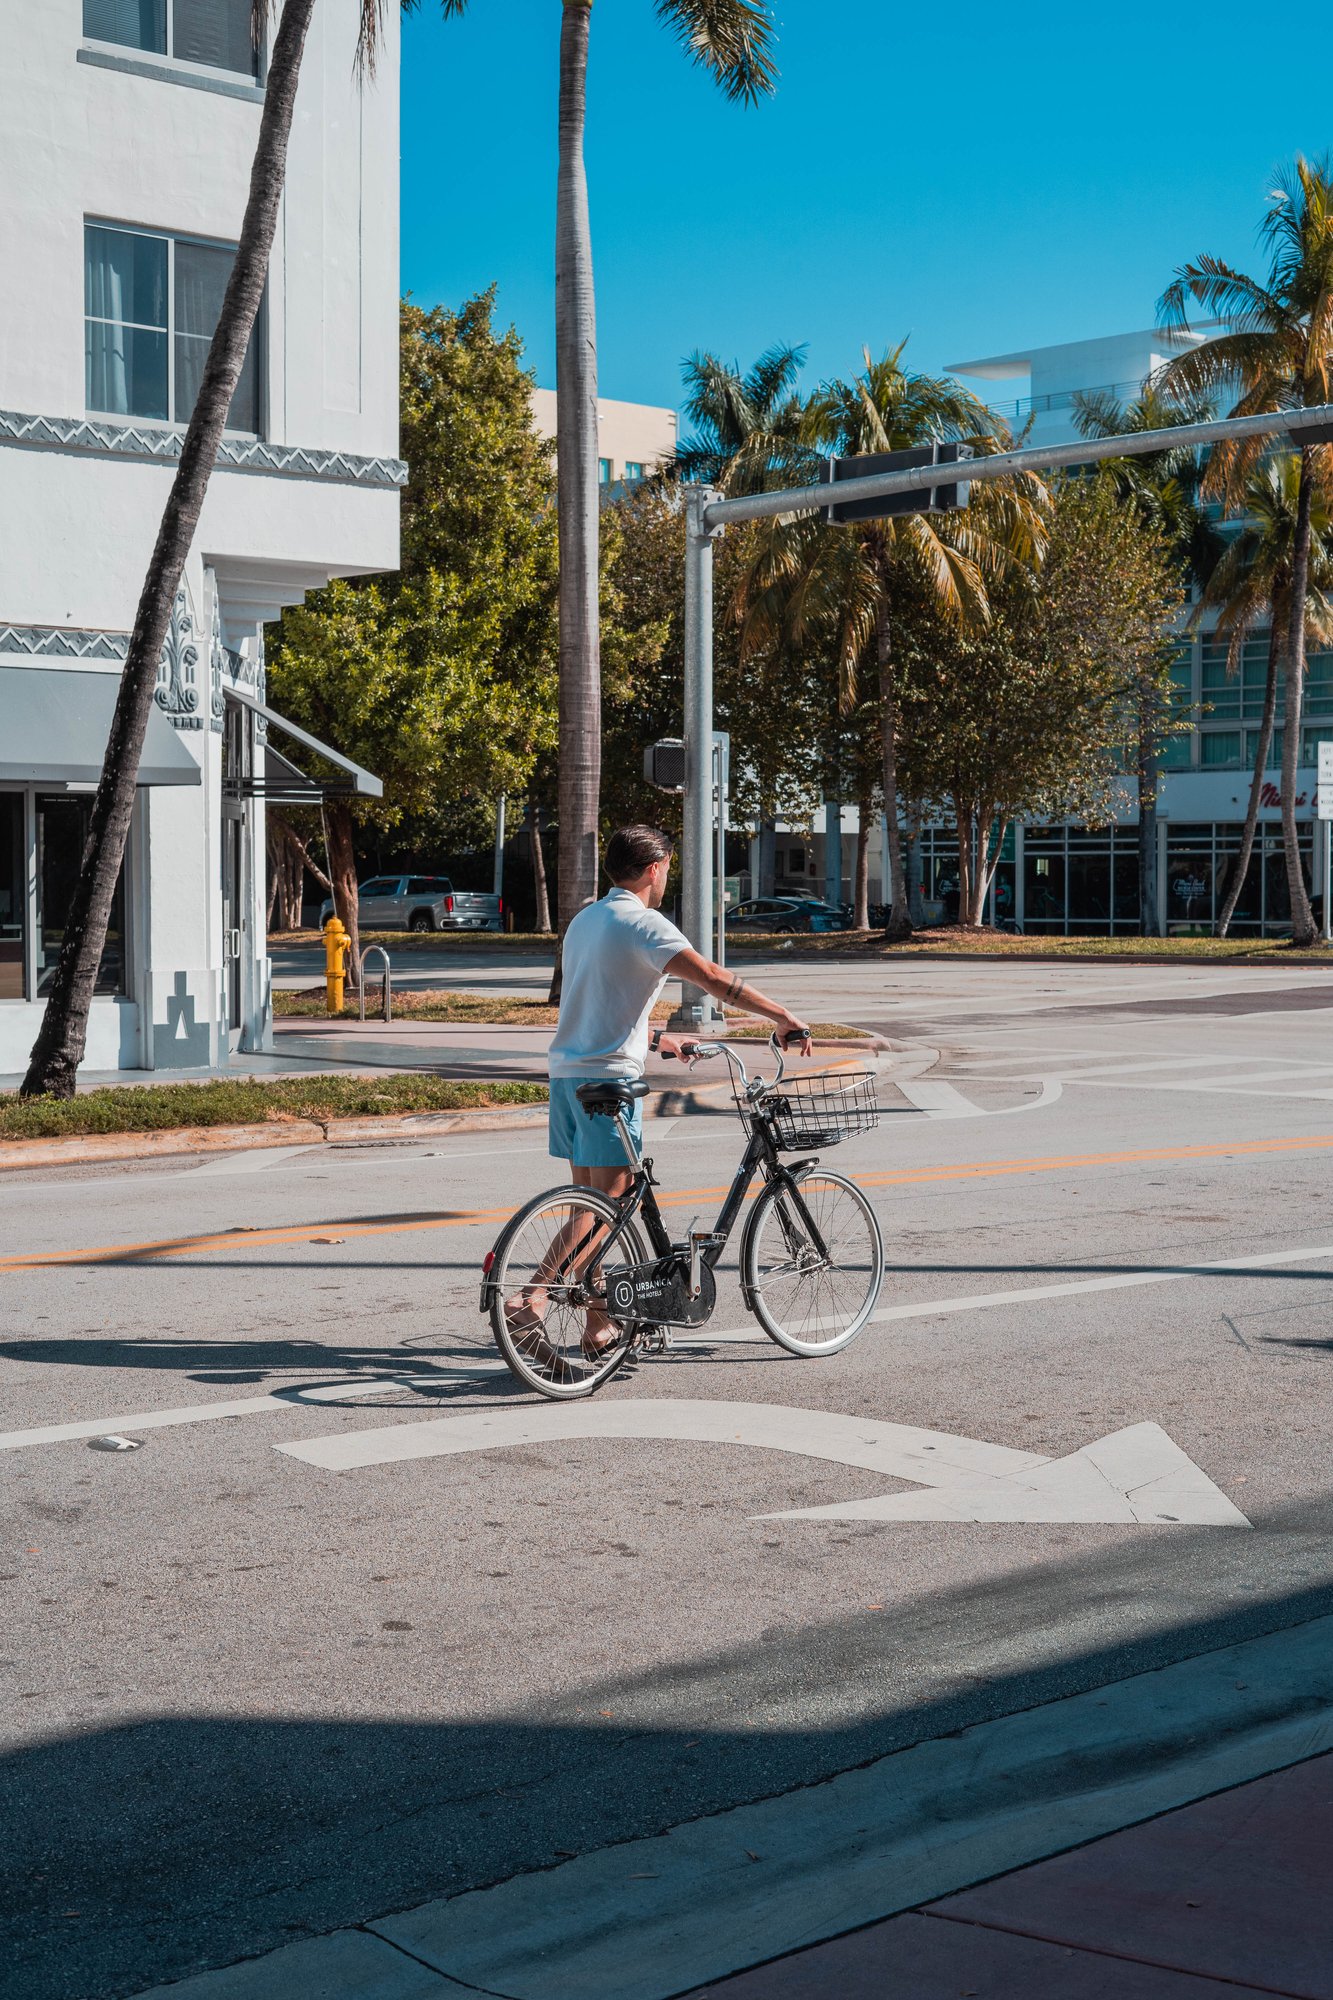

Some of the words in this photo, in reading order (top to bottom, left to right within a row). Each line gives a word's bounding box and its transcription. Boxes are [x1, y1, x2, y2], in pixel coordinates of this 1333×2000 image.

[1248, 782, 1308, 807] Mii
[635, 1278, 672, 1292] URBANICA
[646, 1290, 662, 1298] HOTELS
